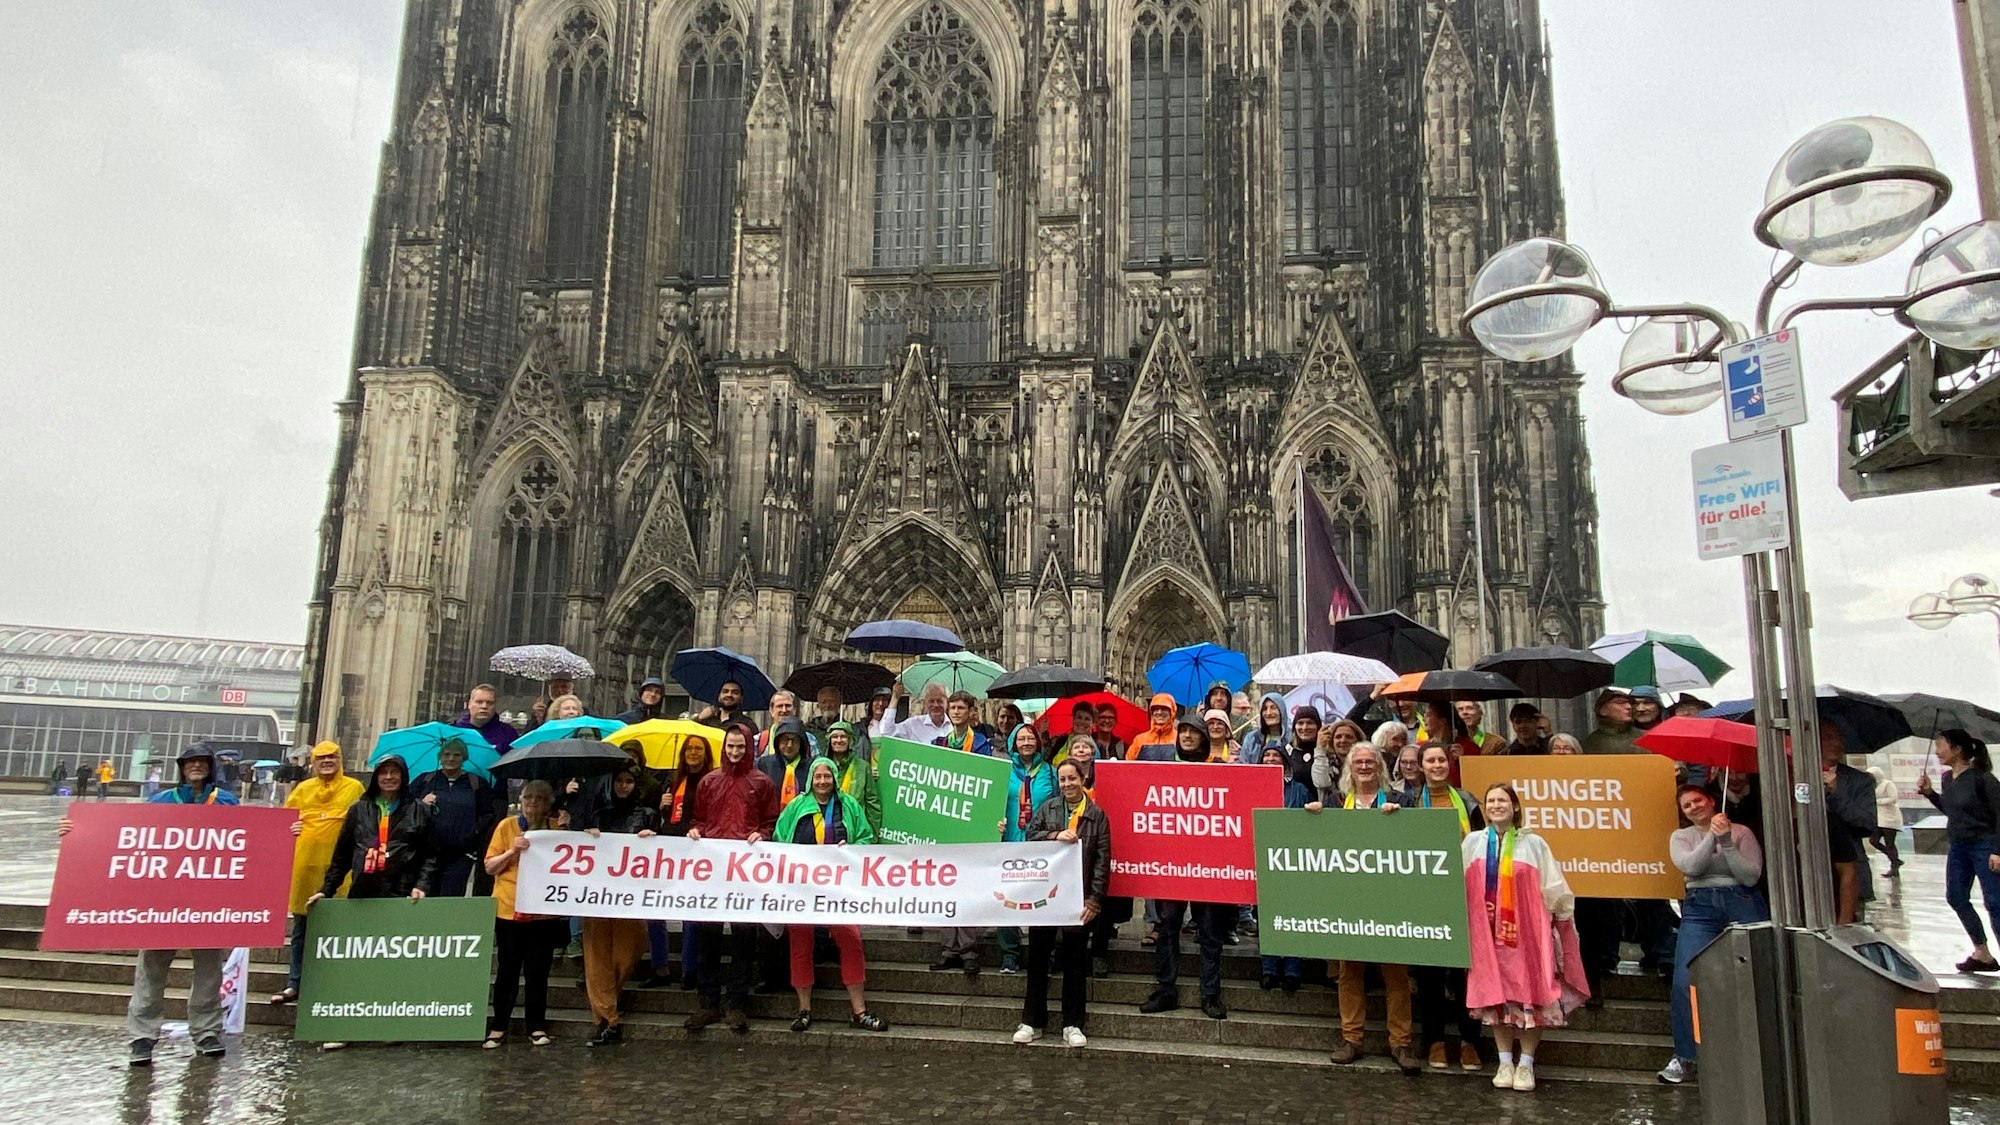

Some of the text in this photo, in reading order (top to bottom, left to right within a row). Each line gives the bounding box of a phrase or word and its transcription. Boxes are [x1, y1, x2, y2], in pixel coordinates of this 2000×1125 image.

[1699, 480, 1780, 508] Free WiFi
[1700, 500, 1767, 525] für alle!
[224, 691, 243, 702] DB
[889, 759, 993, 799] GESUNDHEIT
[1511, 779, 1624, 801] HUNGER
[895, 783, 973, 821] FÜR ALLE
[1144, 785, 1229, 809] ARMUT
[1132, 812, 1242, 837] BEENDEN
[1523, 807, 1632, 830] EENDEN
[117, 826, 247, 851] BILDUNG
[108, 851, 247, 879] FÜR ALLE
[549, 844, 958, 887] 25 Jahre Kölner Kette
[1110, 859, 1257, 881] #stattSchuldendien
[1267, 847, 1450, 875] KLIMASCHUTZ
[1561, 858, 1666, 875] uldendienst
[1001, 870, 1049, 879] erlassjahr.de
[544, 885, 957, 918] 25 Jahre Einsatz für faire Entschuldung
[66, 908, 271, 924] #stattSchuldendienst
[1273, 915, 1452, 940] #stattSchuldendienst
[316, 935, 481, 959] KLIMASCHUTZ
[311, 1001, 473, 1017] #stattSchuldendienst
